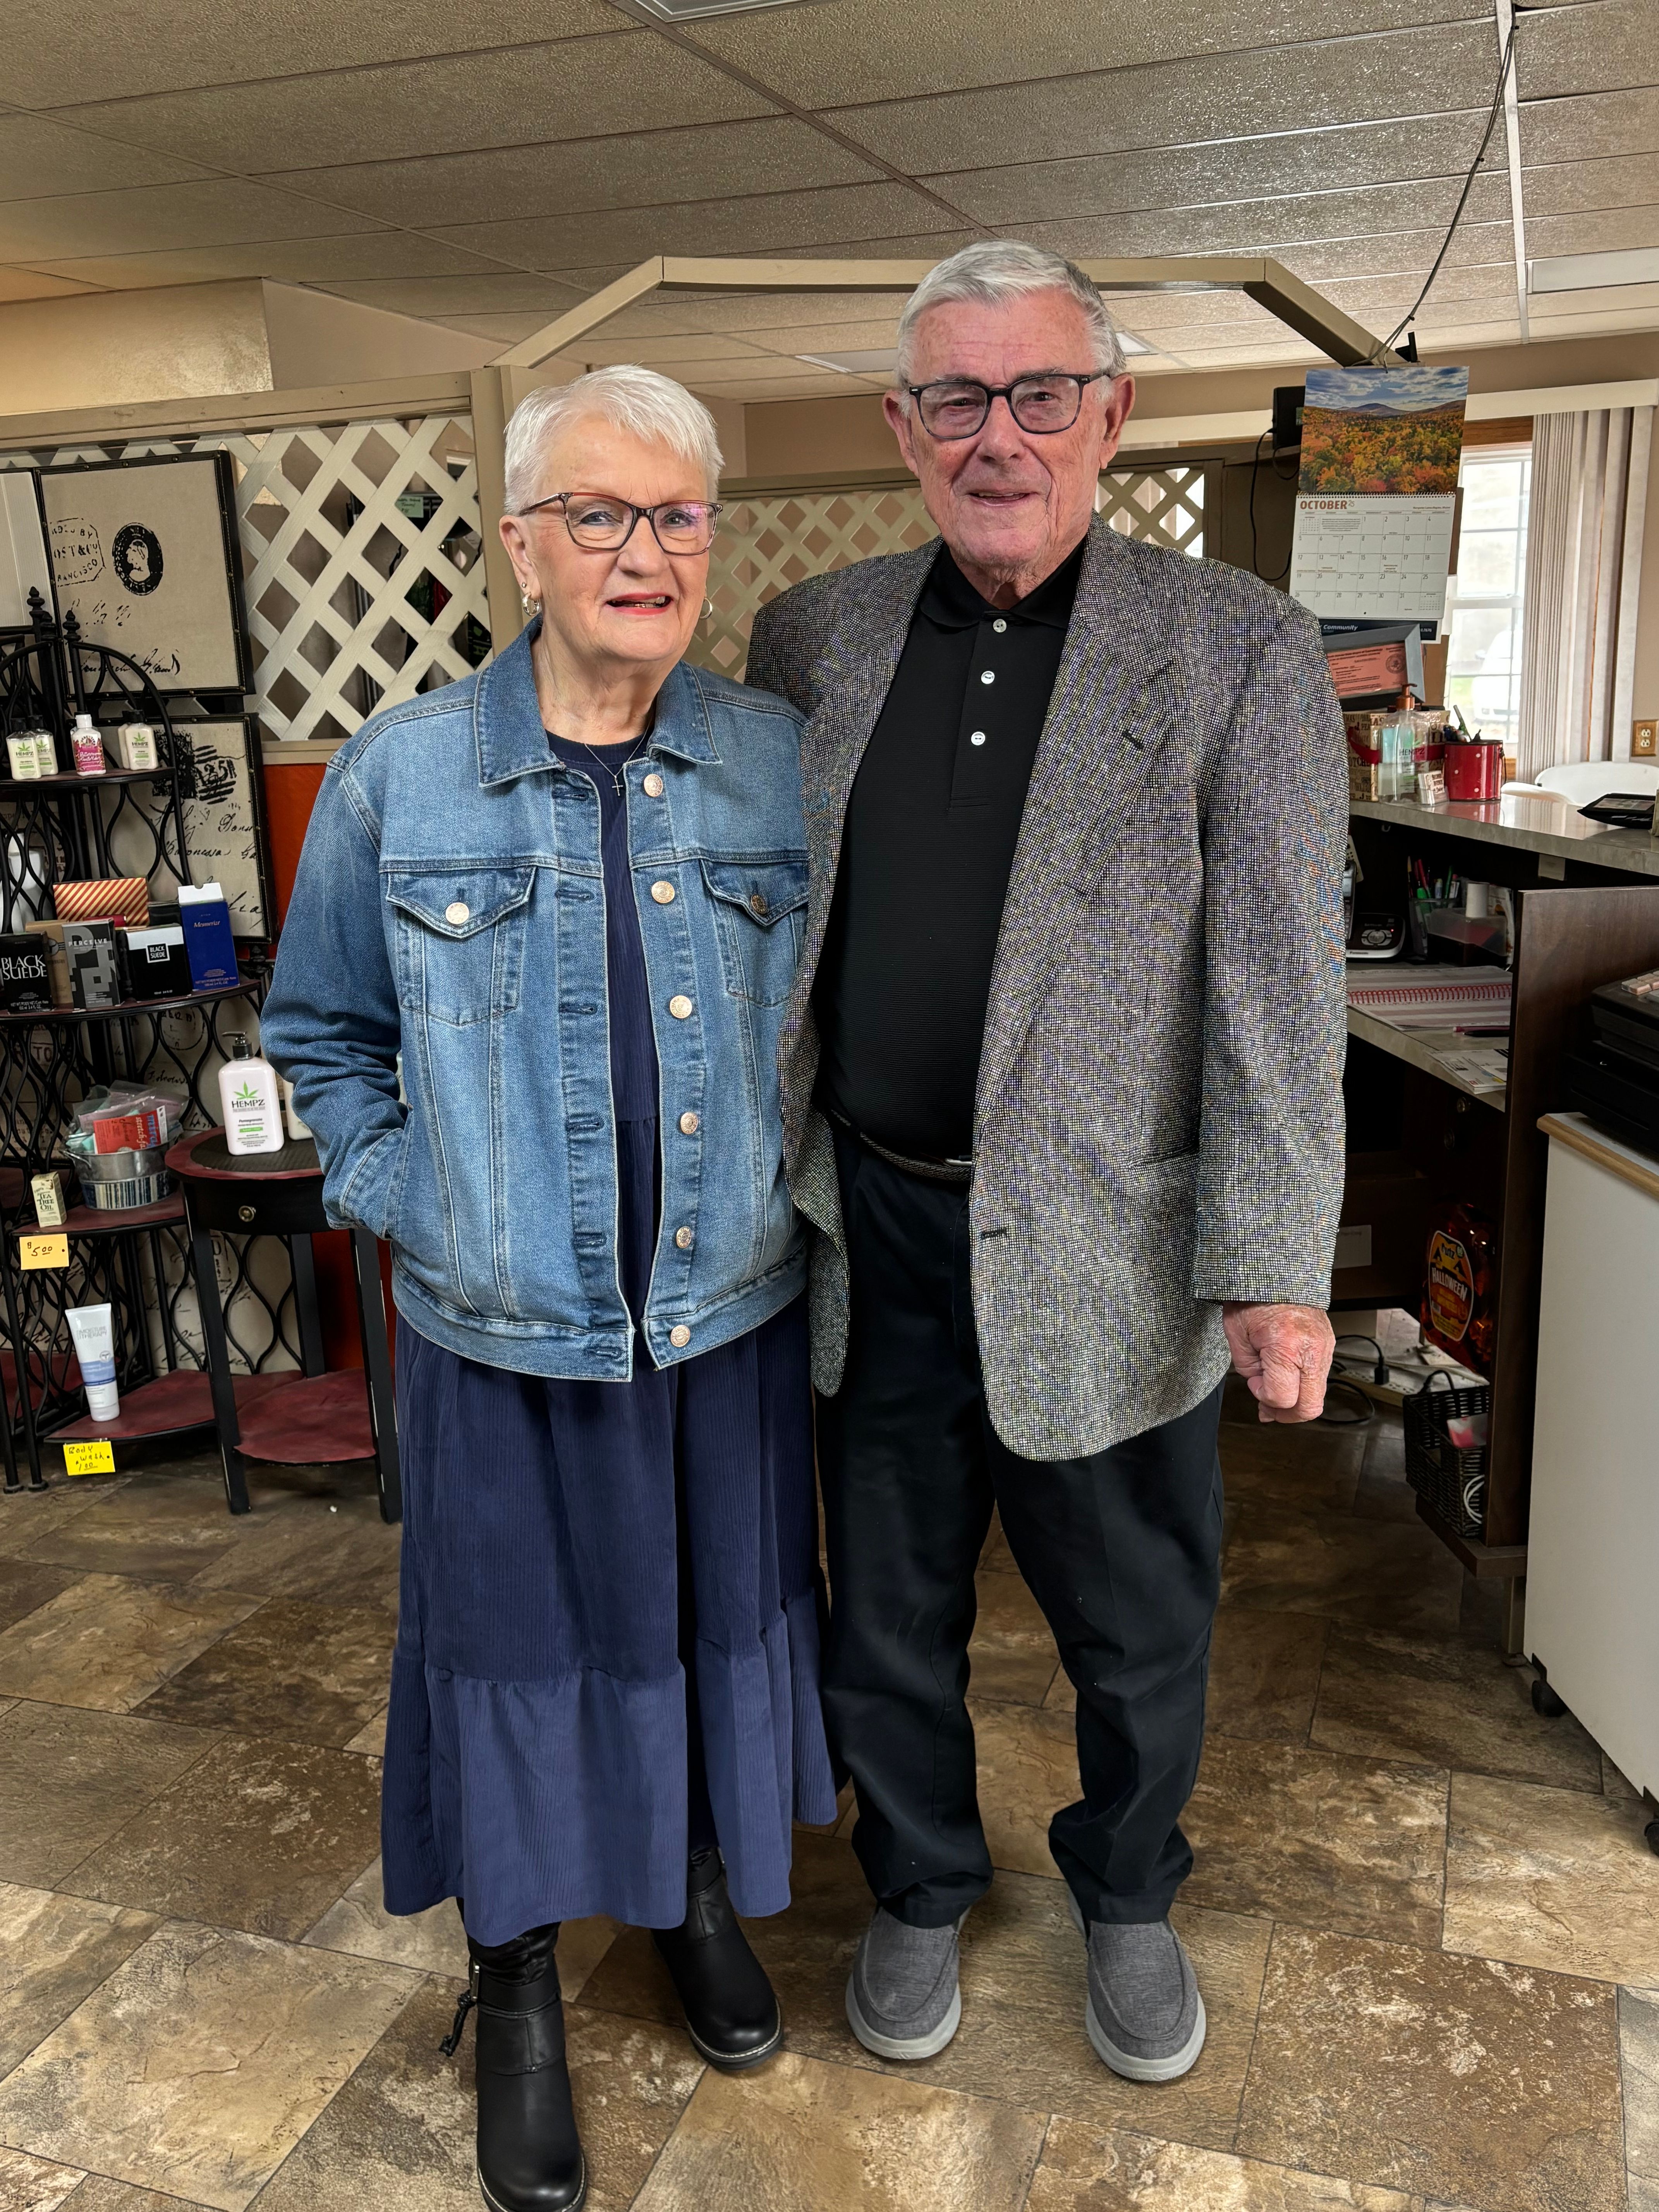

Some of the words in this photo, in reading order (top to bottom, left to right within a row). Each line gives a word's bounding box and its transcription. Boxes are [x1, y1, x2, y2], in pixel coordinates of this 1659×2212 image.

[1300, 500, 1347, 510] OCTOBER
[80, 529, 93, 539] BY
[69, 938, 108, 946] PERCEIVE
[1, 954, 46, 969] BLACK
[3, 966, 47, 980] SUEDE
[232, 1099, 265, 1108] HEMPZ
[1432, 1267, 1468, 1302] HALLOWEEN
